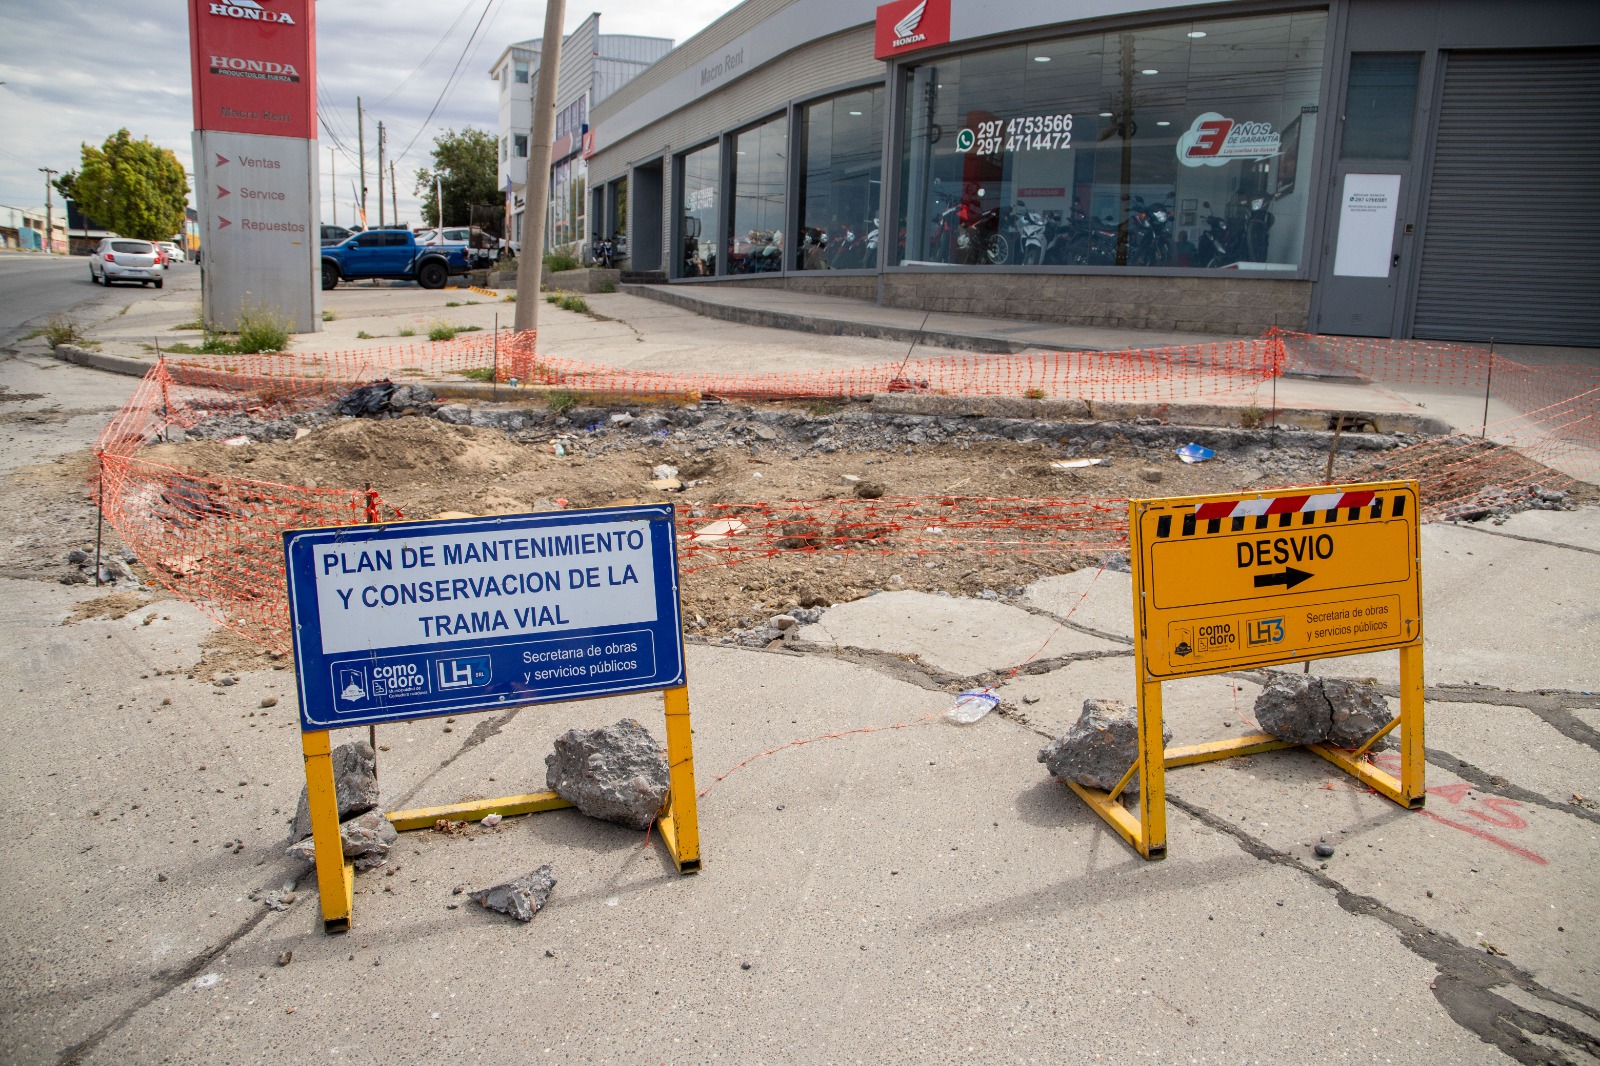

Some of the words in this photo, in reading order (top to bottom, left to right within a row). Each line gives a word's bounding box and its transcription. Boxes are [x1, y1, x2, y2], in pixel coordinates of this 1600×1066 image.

[209, 3, 296, 24] HONDA
[892, 34, 926, 47] HONDA
[210, 56, 300, 76] HONDA
[218, 68, 258, 79] PRODUCTOS
[268, 74, 292, 82] FUERZA
[700, 68, 723, 86] Macro
[724, 48, 744, 73] Rent
[221, 106, 258, 119] Macro
[976, 120, 1004, 139] 297
[1006, 114, 1072, 134] 4753566
[976, 137, 1002, 155] 297
[1006, 132, 1071, 152] 4714472
[1188, 120, 1233, 156] 3
[1231, 122, 1270, 136] AÑOS
[1240, 134, 1278, 143] GARANTÍA
[239, 156, 281, 169] Ventas
[240, 188, 285, 200] Service
[241, 219, 305, 232] Repuestos
[323, 549, 393, 575] PLAN
[401, 546, 436, 568] DE
[443, 530, 644, 565] MANTENIMIENTO
[1237, 533, 1334, 568] DESVIO
[336, 588, 353, 609] Y
[362, 570, 560, 607] CONSERVACION
[568, 567, 600, 589] DE
[608, 564, 638, 586] LA
[419, 610, 509, 637] TRAMA
[514, 604, 569, 628] VIAL
[1306, 609, 1350, 624] Secretaria
[1352, 607, 1362, 617] de
[1365, 605, 1388, 616] obras
[1199, 624, 1230, 636] como
[1210, 633, 1235, 645] doro
[1307, 631, 1312, 642] y
[1314, 624, 1351, 639] servicios
[1354, 620, 1388, 634] públicos
[523, 648, 583, 663] Secretaria
[587, 644, 602, 656] de
[605, 642, 638, 655] obras
[373, 663, 417, 678] como
[524, 672, 531, 685] y
[534, 665, 586, 681] servicios
[590, 660, 637, 677] públicos
[388, 674, 424, 689] doro
